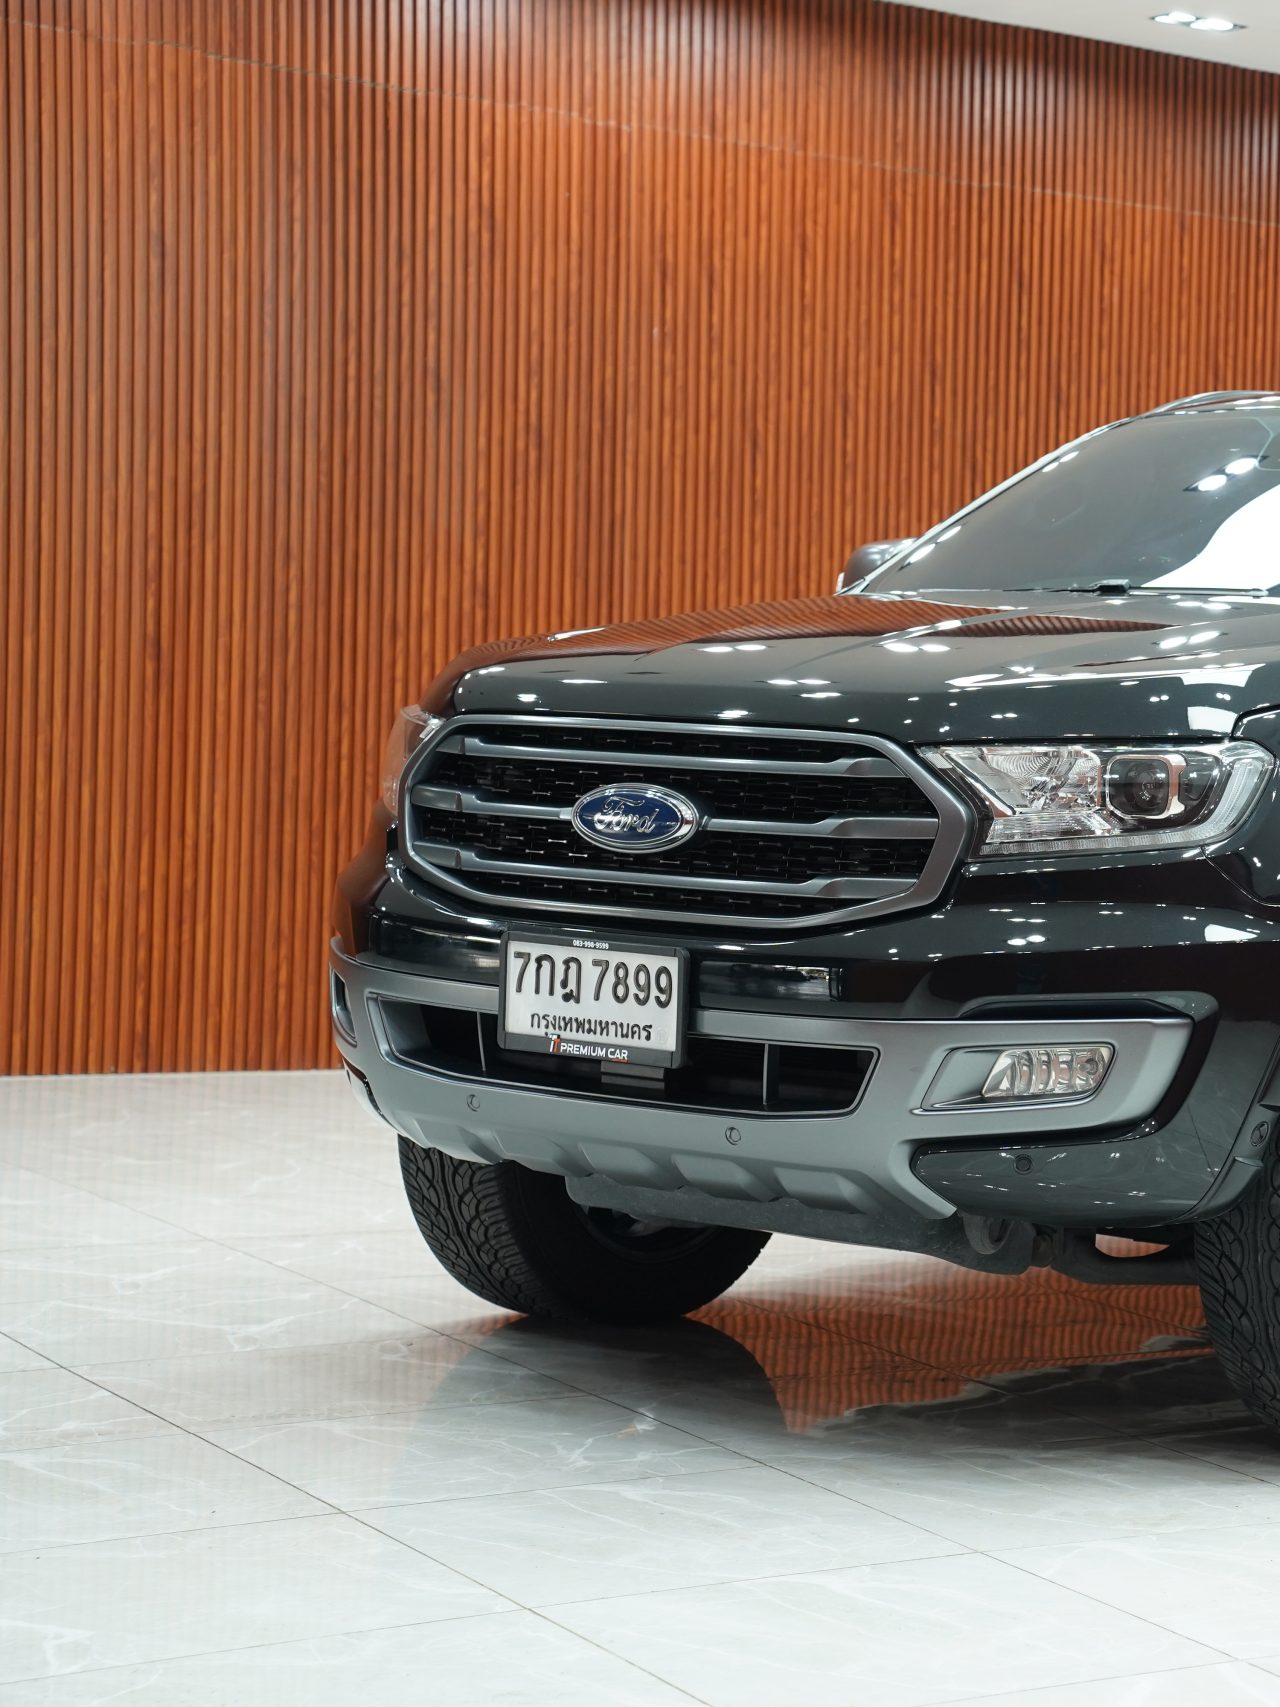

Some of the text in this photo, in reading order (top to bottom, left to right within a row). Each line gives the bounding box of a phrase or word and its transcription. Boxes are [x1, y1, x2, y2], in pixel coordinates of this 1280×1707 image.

[594, 796, 660, 833] Ford
[592, 958, 673, 1009] 7899
[530, 1012, 653, 1042] กรุงเทพมหานคร
[560, 1042, 606, 1058] PREMIUM
[607, 1048, 629, 1060] CAR
